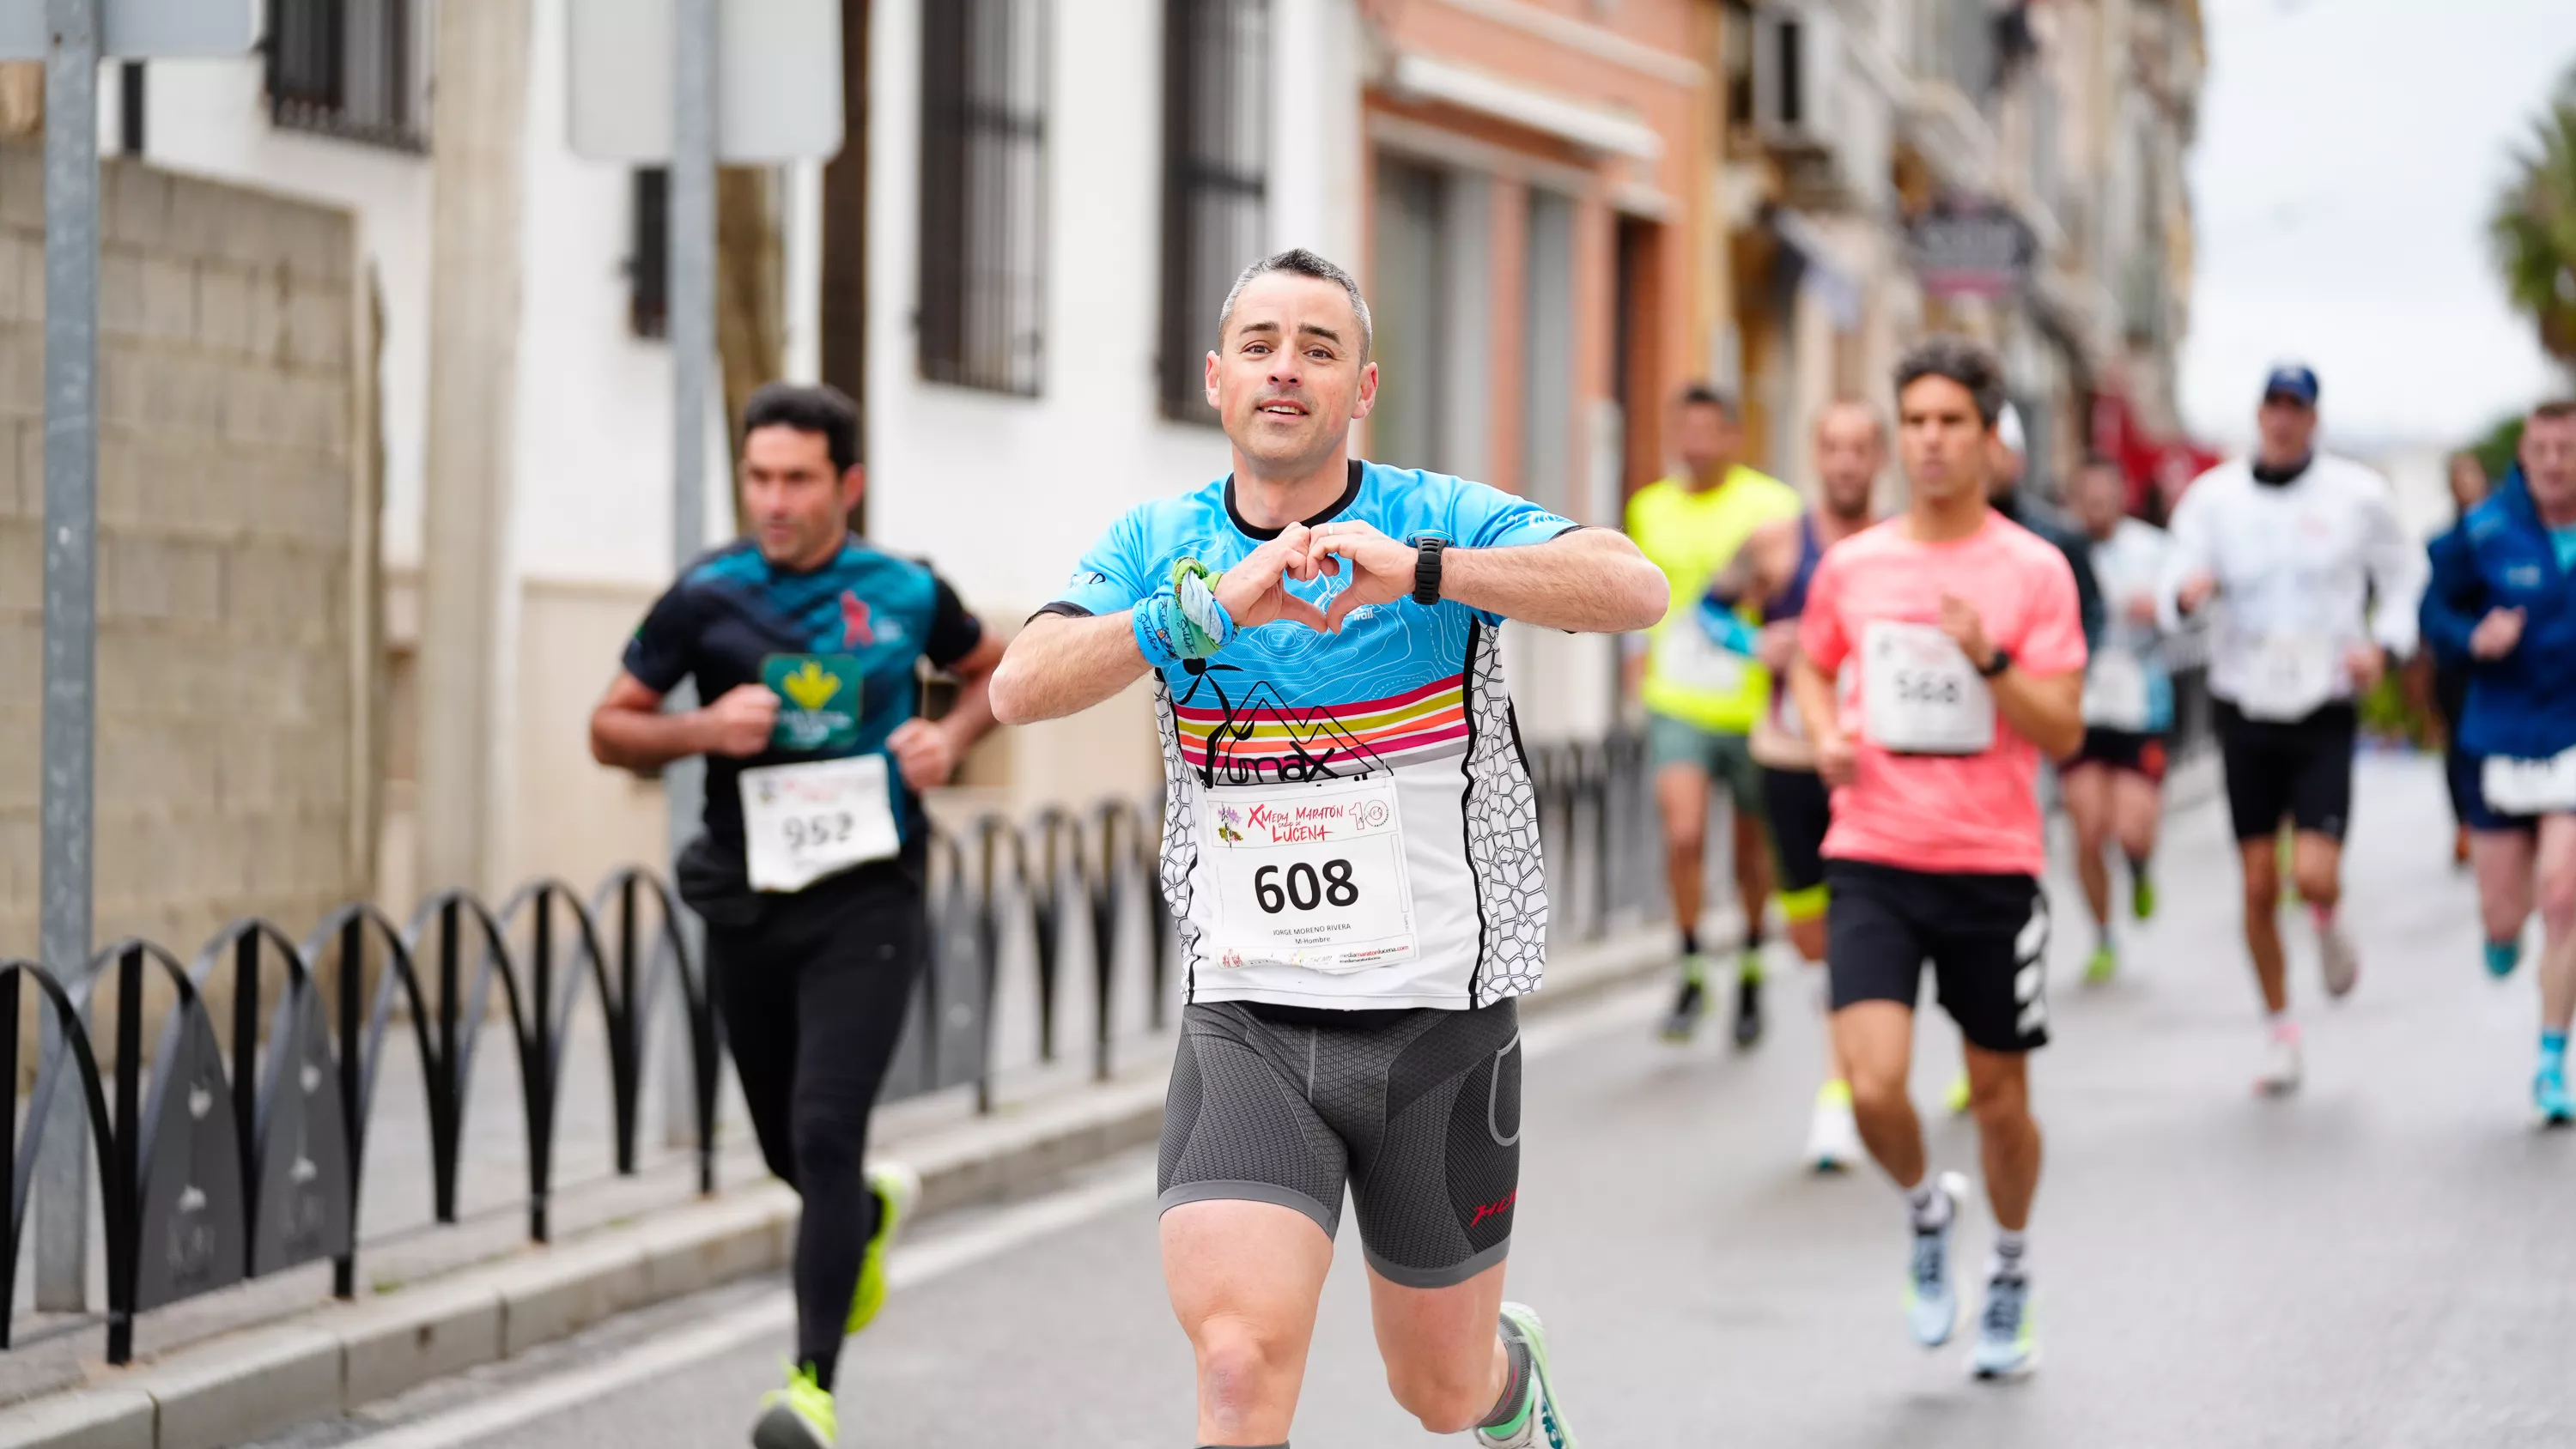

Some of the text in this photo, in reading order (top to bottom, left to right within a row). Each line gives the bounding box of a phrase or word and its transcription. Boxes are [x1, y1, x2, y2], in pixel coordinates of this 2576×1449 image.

[1892, 669, 1963, 705] 568
[782, 811, 854, 852] 952
[1272, 824, 1335, 843] LUCENA
[1255, 859, 1359, 914] 608
[1294, 925, 1325, 935] MORENO
